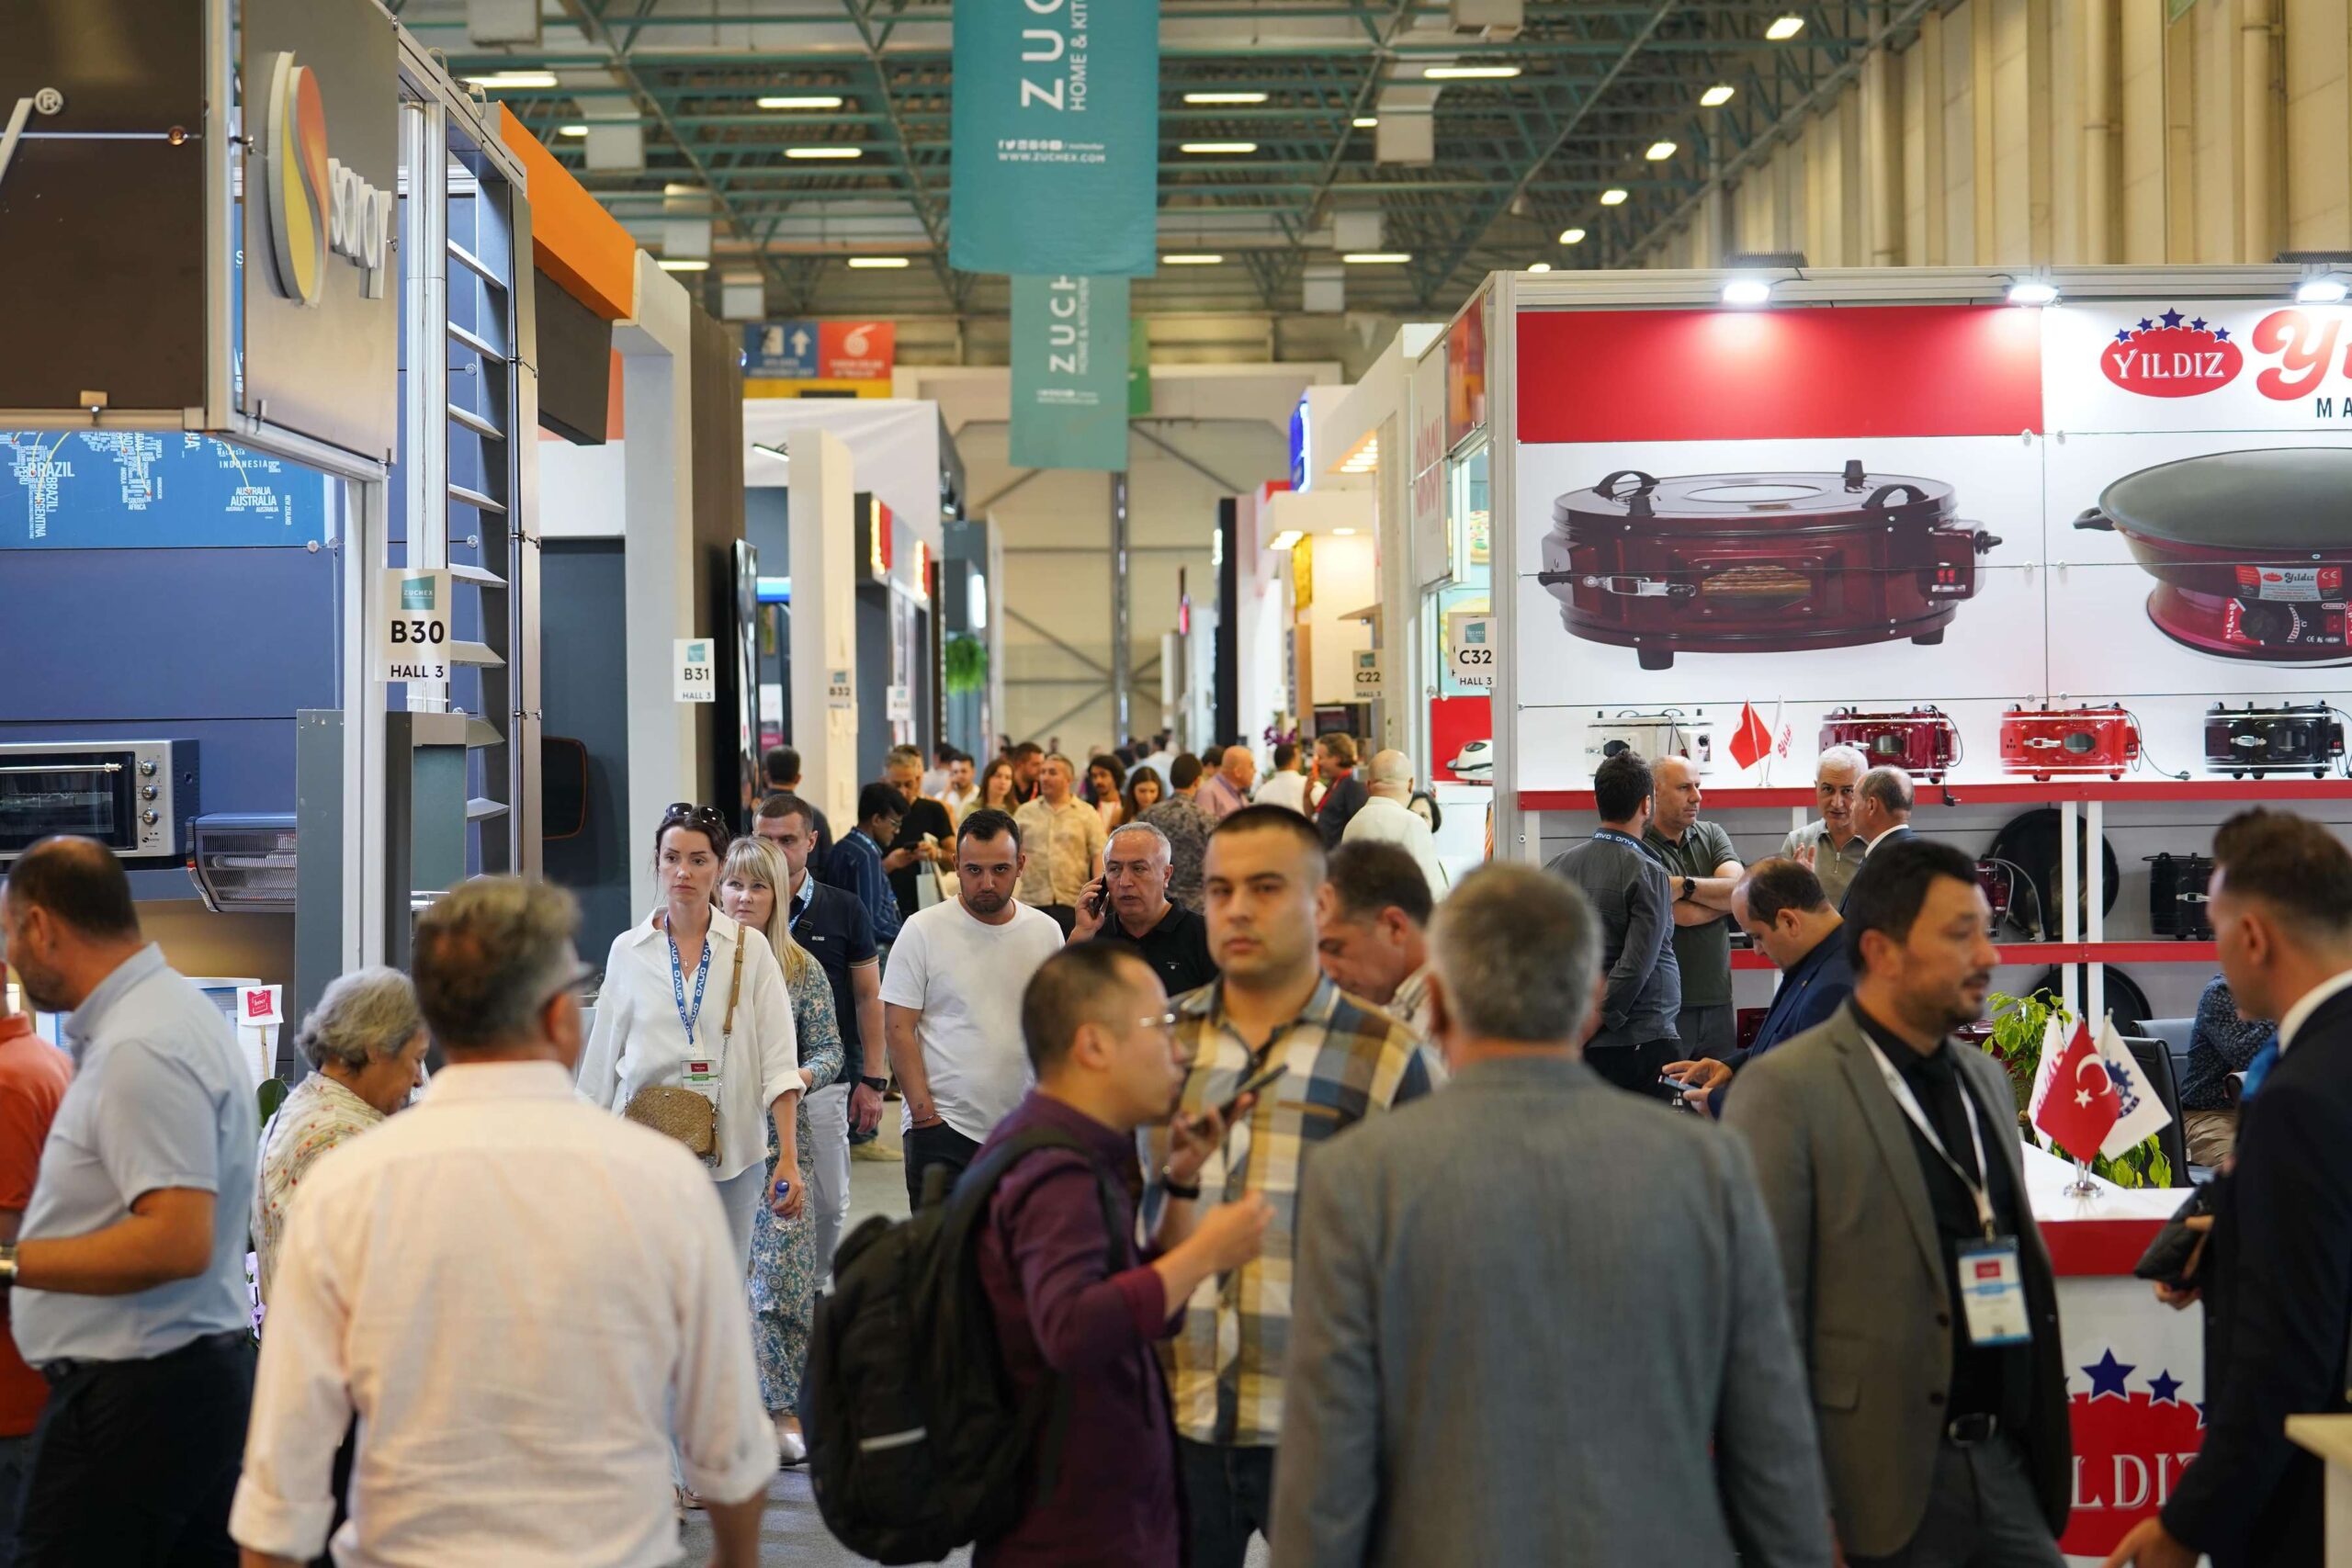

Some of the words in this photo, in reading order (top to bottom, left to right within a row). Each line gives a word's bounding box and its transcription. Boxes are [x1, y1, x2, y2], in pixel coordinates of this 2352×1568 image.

[1071, 0, 1088, 28] KIT
[1070, 34, 1087, 49] &
[1069, 54, 1087, 111] HOME
[2112, 348, 2225, 379] YILDIZ
[28, 462, 75, 478] BRAZIL
[220, 460, 268, 468] INDONESIA
[18, 467, 29, 485] PERU
[46, 478, 58, 507] BRAZIL
[235, 487, 271, 496] AUSTRALIA
[230, 496, 277, 506] AUSTRALIA
[35, 492, 47, 538] ARGENTINA
[390, 620, 446, 644] B30
[1459, 649, 1493, 665] C32
[390, 664, 429, 678] HALL
[435, 665, 445, 679] 3
[684, 668, 709, 681] B31
[1355, 671, 1382, 683] C22
[1459, 677, 1484, 686] HALL
[1486, 676, 1493, 686] 3
[682, 692, 704, 700] HALL
[706, 691, 712, 700] 3
